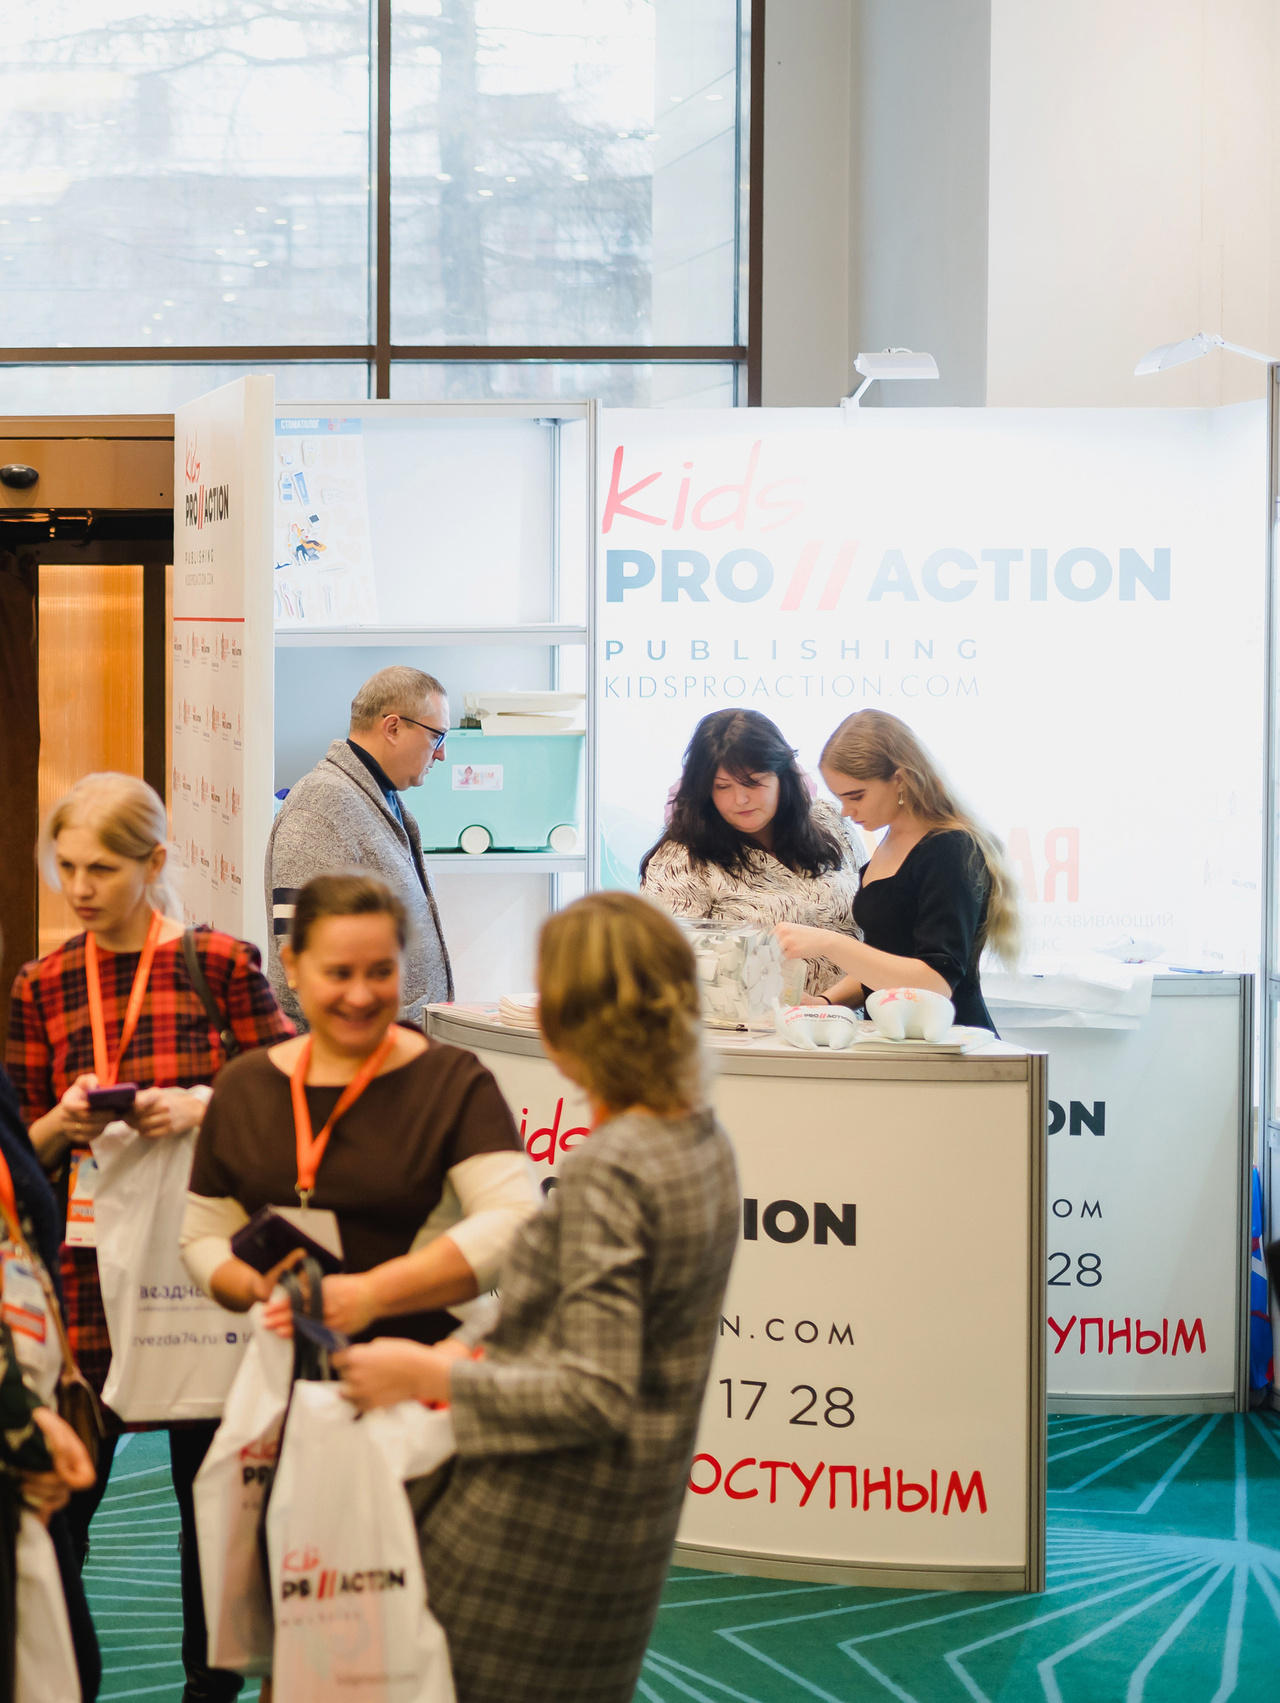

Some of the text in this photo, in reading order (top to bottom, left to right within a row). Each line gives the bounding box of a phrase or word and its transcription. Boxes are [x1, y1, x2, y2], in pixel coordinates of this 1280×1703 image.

[601, 440, 812, 534] kids
[604, 638, 979, 662] PUBLISHING
[604, 675, 980, 699] KIDSPROACTION.COM
[1047, 1252, 1102, 1287] 28
[719, 1378, 856, 1429] 17 28
